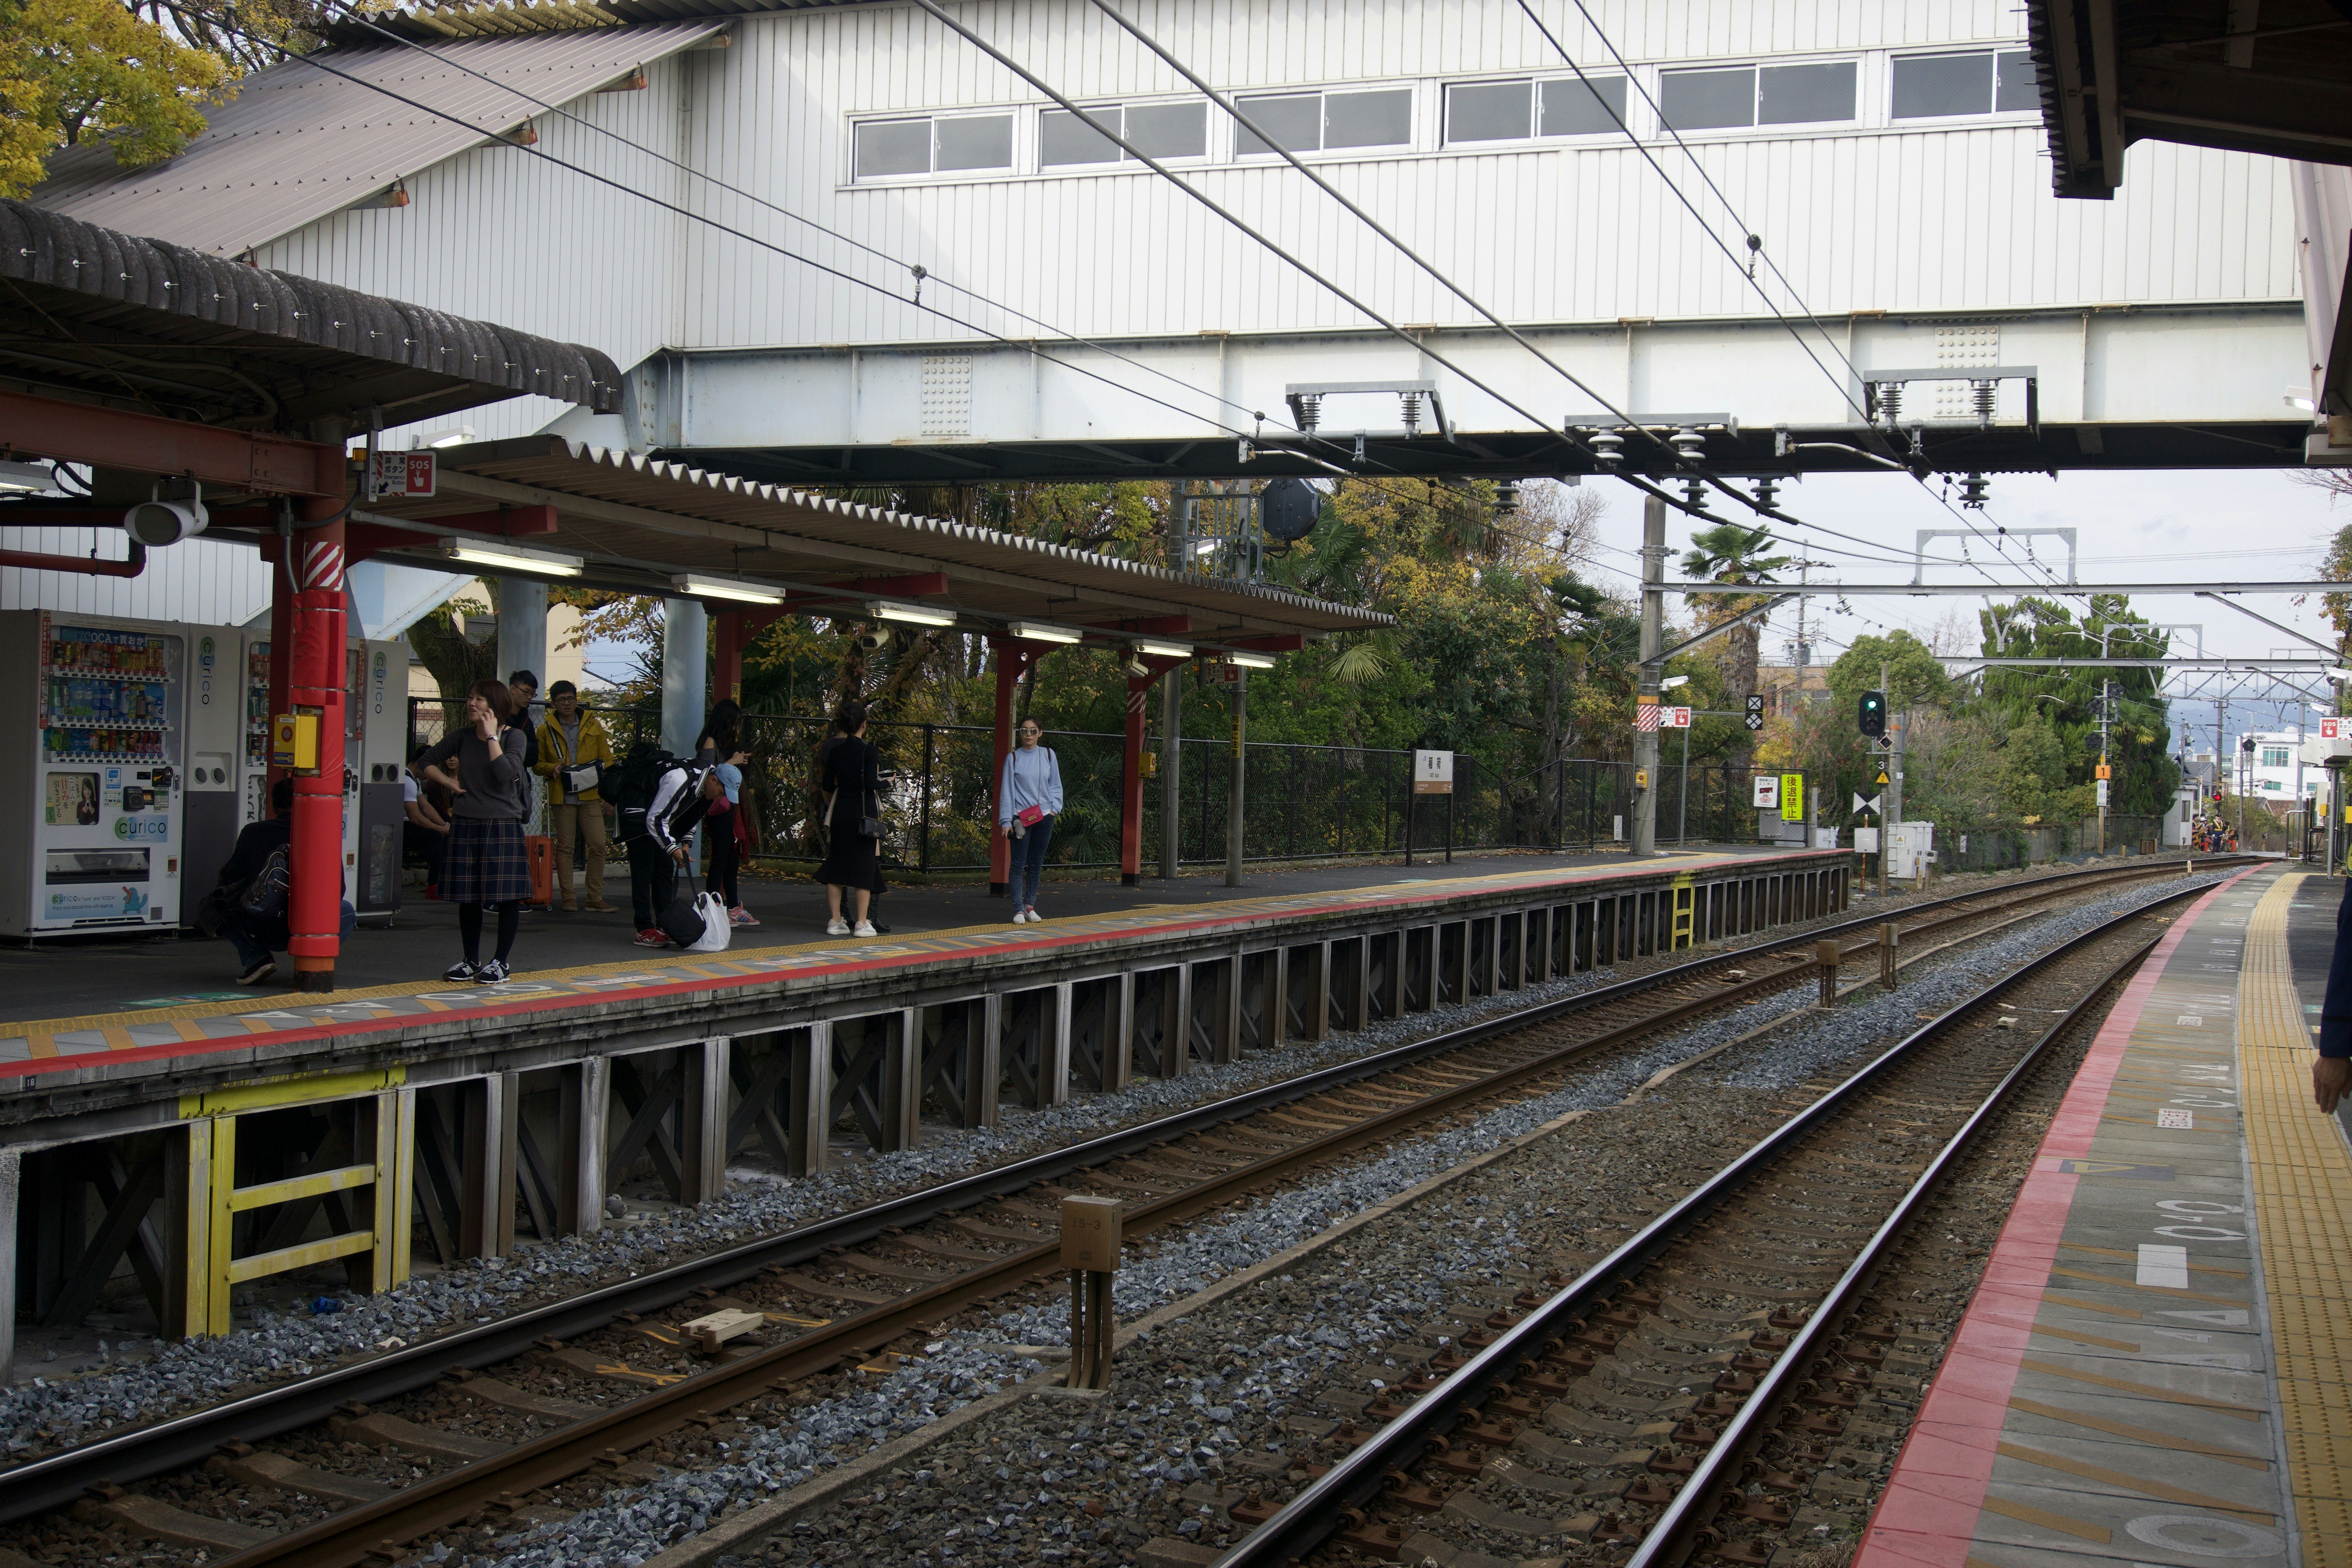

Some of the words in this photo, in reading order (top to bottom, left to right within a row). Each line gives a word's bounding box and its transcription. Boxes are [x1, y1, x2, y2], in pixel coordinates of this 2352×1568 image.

[410, 460, 429, 469] SOS
[202, 642, 212, 705] curico
[375, 657, 384, 714] curico
[1428, 757, 1441, 769] 稲荷
[1878, 761, 1885, 769] 3
[2102, 767, 2105, 777] 1
[60, 779, 70, 809] 甘みを
[1787, 776, 1797, 818] 後退禁止
[119, 820, 166, 833] curico
[27, 1078, 34, 1087] 18
